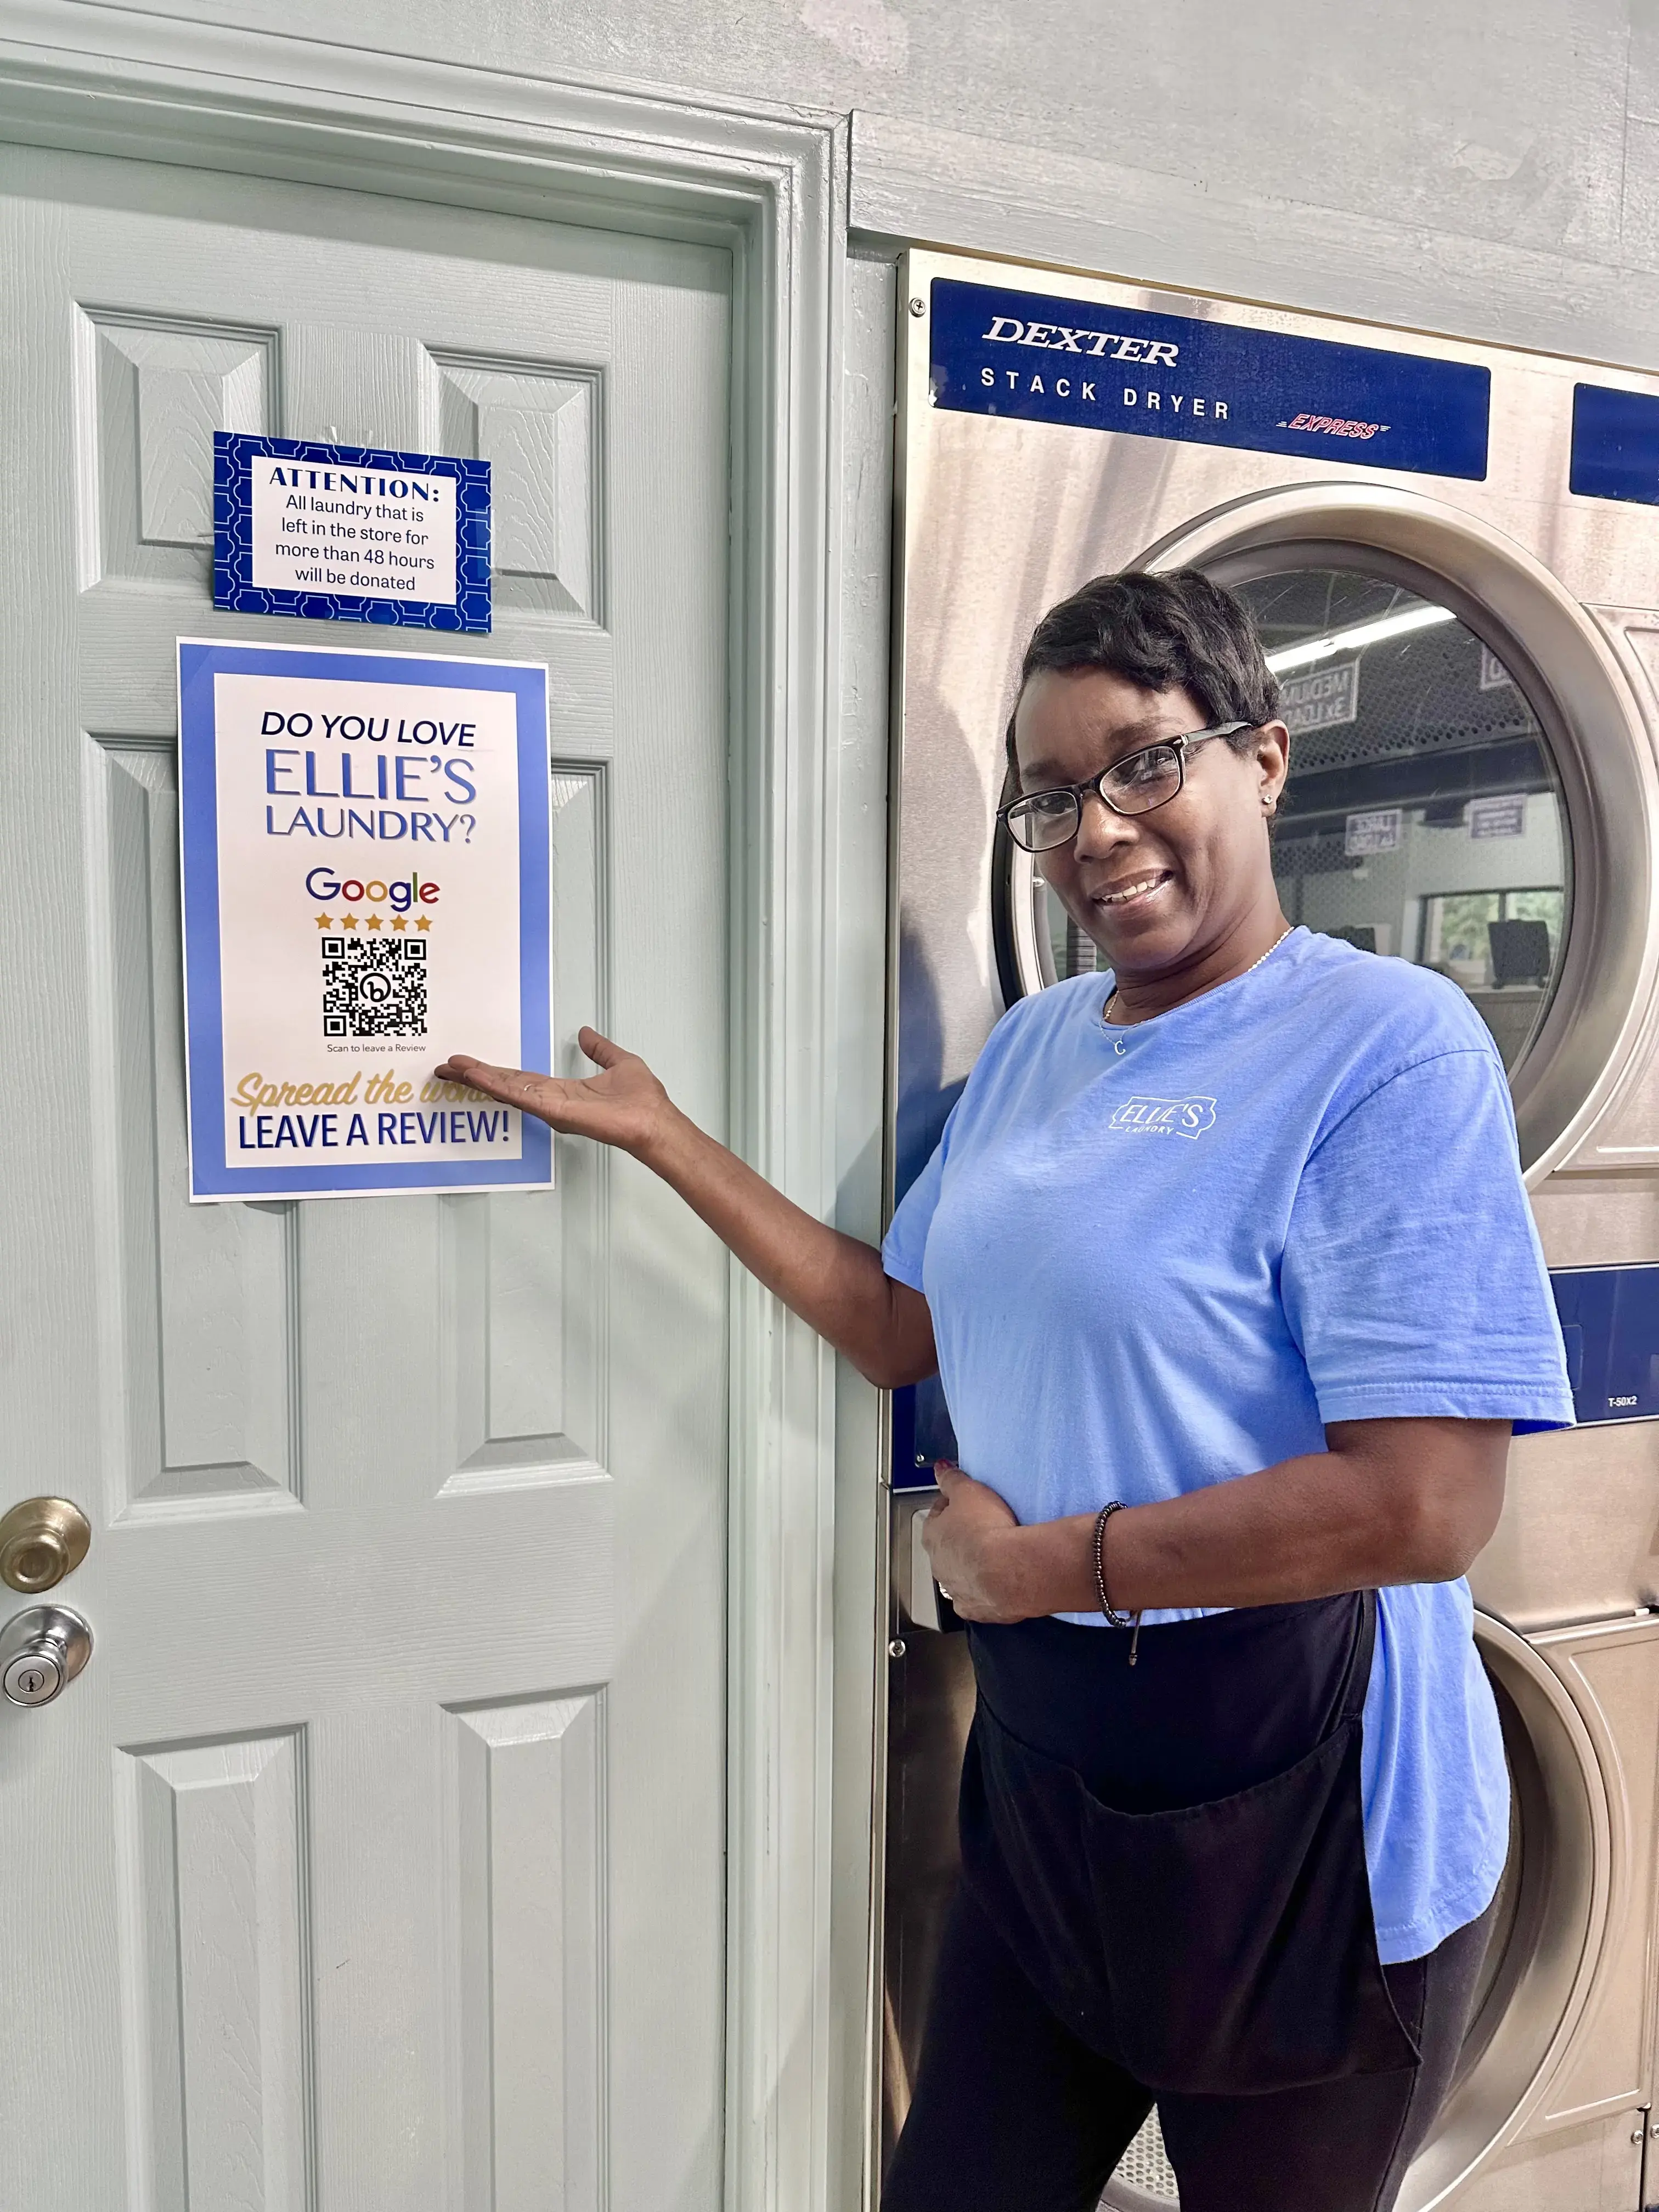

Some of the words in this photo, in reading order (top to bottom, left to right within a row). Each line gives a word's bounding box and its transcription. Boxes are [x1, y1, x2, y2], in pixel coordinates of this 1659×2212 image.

[981, 316, 1180, 367] DEXTER
[981, 368, 1096, 400] STACK
[1124, 388, 1228, 420] DRYER
[1288, 413, 1379, 439] EXPRESS
[269, 467, 439, 503] ATTENTION:
[286, 494, 306, 510] All
[311, 496, 371, 520] laundry
[376, 503, 407, 521] that
[411, 505, 424, 522] is
[282, 517, 307, 534] left
[312, 520, 326, 535] in
[330, 522, 356, 539] the
[360, 526, 402, 543] store
[405, 529, 429, 545] for
[275, 544, 319, 559] more
[324, 546, 359, 563] than
[363, 549, 384, 565] 48
[388, 552, 435, 569] hours
[295, 567, 321, 583] will
[327, 569, 346, 584] be
[350, 571, 415, 591] donated
[261, 712, 313, 738] DO
[321, 714, 389, 741] YOU
[397, 719, 476, 747] LOVE
[266, 748, 477, 805] ELLIE'S
[266, 805, 476, 844] LAUNDRY?
[306, 867, 439, 912] Google
[327, 1044, 348, 1052] Scan
[363, 1043, 386, 1052] leave
[396, 1043, 426, 1052] Review
[230, 1071, 362, 1116] Spread
[364, 1069, 414, 1104] the
[239, 1114, 339, 1149] LEAVE
[346, 1113, 369, 1146] A
[378, 1110, 509, 1146] REVIEW!
[1120, 1103, 1203, 1127] ELLIE'S
[1125, 1125, 1174, 1135] LAUNDRY
[1608, 1396, 1638, 1407] T-50X2
